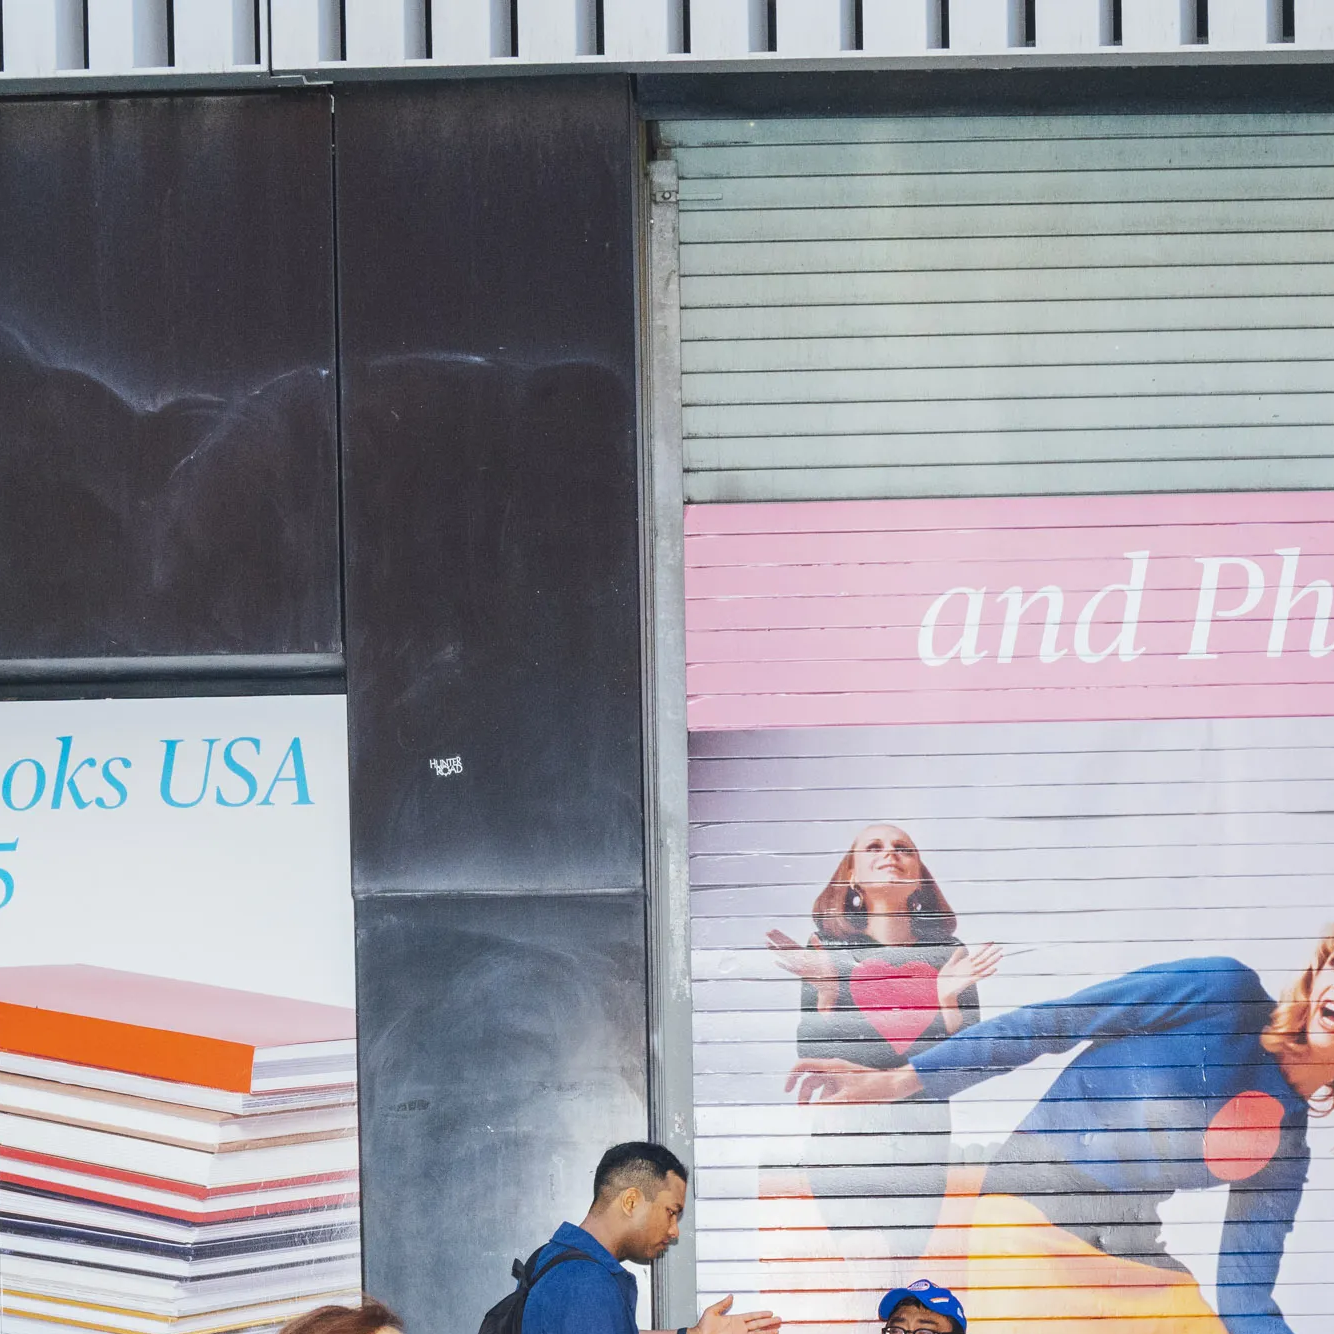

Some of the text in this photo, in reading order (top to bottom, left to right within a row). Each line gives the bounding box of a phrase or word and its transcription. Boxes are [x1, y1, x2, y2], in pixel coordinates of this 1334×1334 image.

[915, 548, 1152, 669] and
[158, 736, 315, 809] USA
[429, 756, 462, 768] HUNTER
